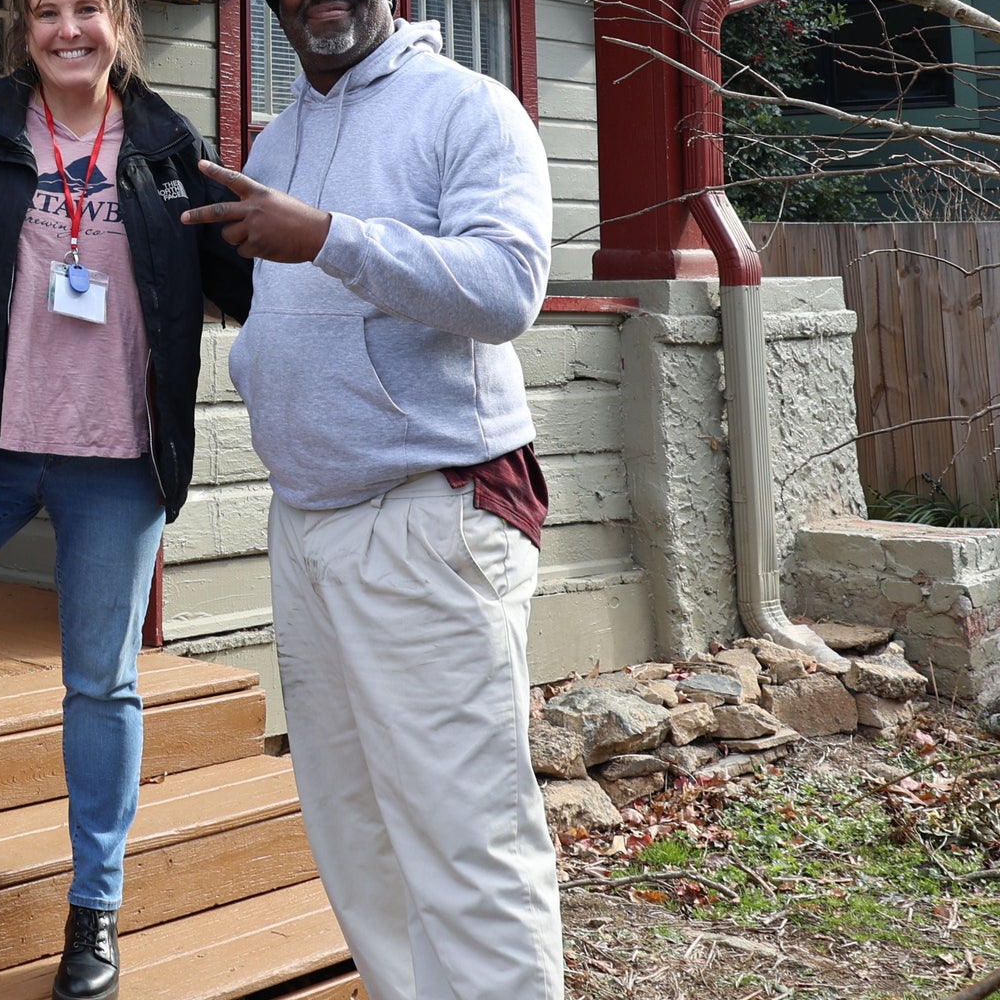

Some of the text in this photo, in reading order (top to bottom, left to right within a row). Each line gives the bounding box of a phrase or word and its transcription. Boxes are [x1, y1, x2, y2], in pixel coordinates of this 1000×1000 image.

[162, 181, 178, 189] THE
[163, 191, 181, 201] FACE
[31, 192, 125, 223] TAWB
[25, 214, 82, 238] rewin
